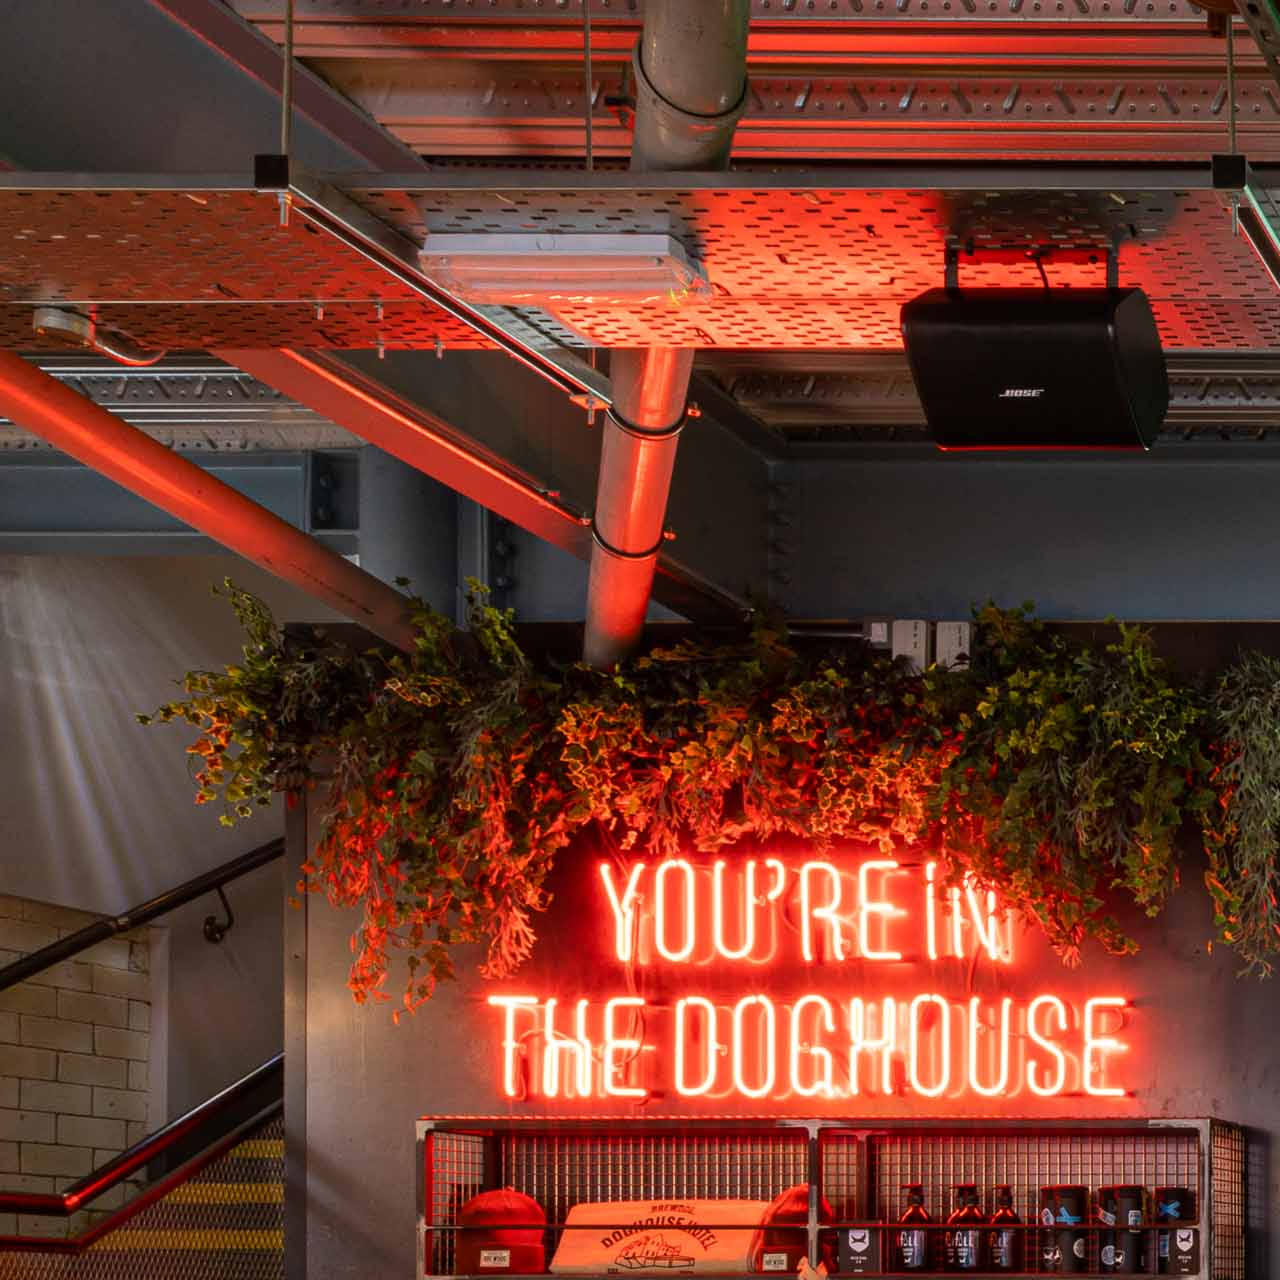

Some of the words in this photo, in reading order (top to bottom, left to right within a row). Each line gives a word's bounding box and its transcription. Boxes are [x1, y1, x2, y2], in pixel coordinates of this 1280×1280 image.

[999, 389, 1044, 397] BOSE
[598, 859, 903, 962] YOU'RE
[488, 996, 646, 1097] THE
[674, 994, 1130, 1098] DOGHOUSE
